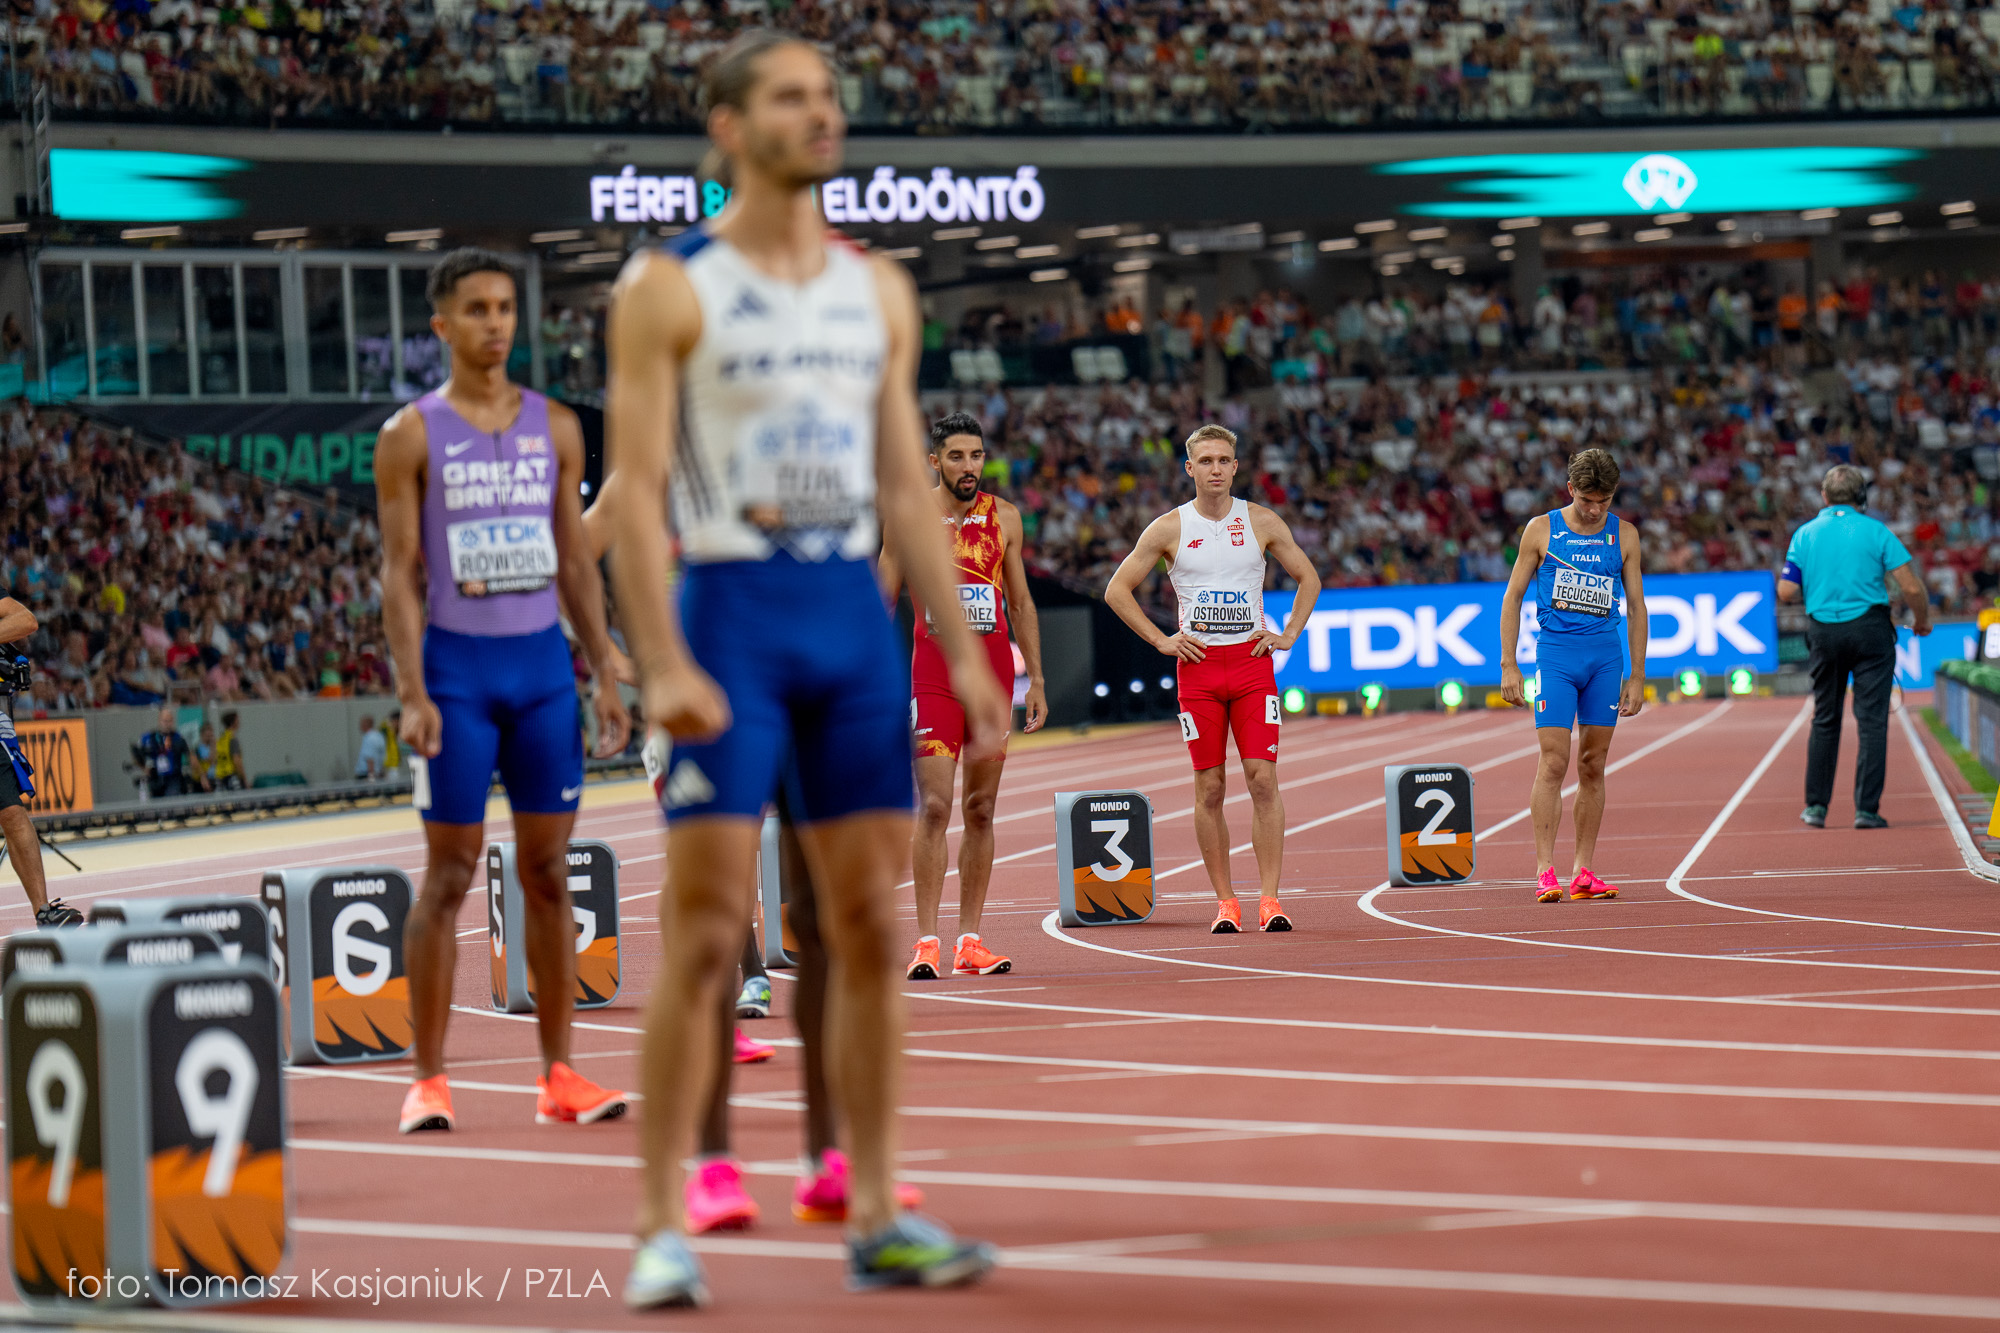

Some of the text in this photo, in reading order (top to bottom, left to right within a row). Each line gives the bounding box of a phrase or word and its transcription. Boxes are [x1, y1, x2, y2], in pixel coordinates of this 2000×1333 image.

[590, 165, 697, 222] FÉRFI
[823, 165, 1045, 223] ELŐDÖNTŐ
[186, 433, 377, 484] BUDAPE
[442, 457, 550, 487] GREAT
[444, 481, 551, 511] BRITAIN
[941, 514, 987, 525] SPAÑA
[484, 522, 541, 544] TDK
[458, 549, 550, 575] ROWDEN
[1571, 554, 1601, 563] ITALIA
[960, 587, 989, 601] DK
[1573, 572, 1608, 590] TDK
[1209, 591, 1248, 604] TDK
[1556, 585, 1610, 607] TECUCEANU
[960, 605, 993, 621] ÓÑEZ
[1193, 606, 1251, 621] OSTROWSKI
[1643, 590, 1767, 659] DK
[1302, 603, 1486, 673] TDK
[1361, 683, 1383, 710] 7
[1271, 700, 1278, 720] 3
[1182, 717, 1190, 737] 3
[18, 728, 76, 811] IKO
[1414, 773, 1453, 783] MONDO
[1090, 801, 1130, 812] MONDO
[1414, 788, 1456, 846] 2
[565, 852, 592, 866] NDO
[1090, 819, 1134, 882] 3
[332, 880, 387, 898] MONDO
[181, 909, 241, 931] MONDO
[491, 879, 503, 958] 5
[127, 937, 194, 965] MONDO
[332, 901, 392, 996] 6
[173, 979, 253, 1020] MONDO
[27, 1038, 88, 1209] 9
[174, 1027, 260, 1198] 9
